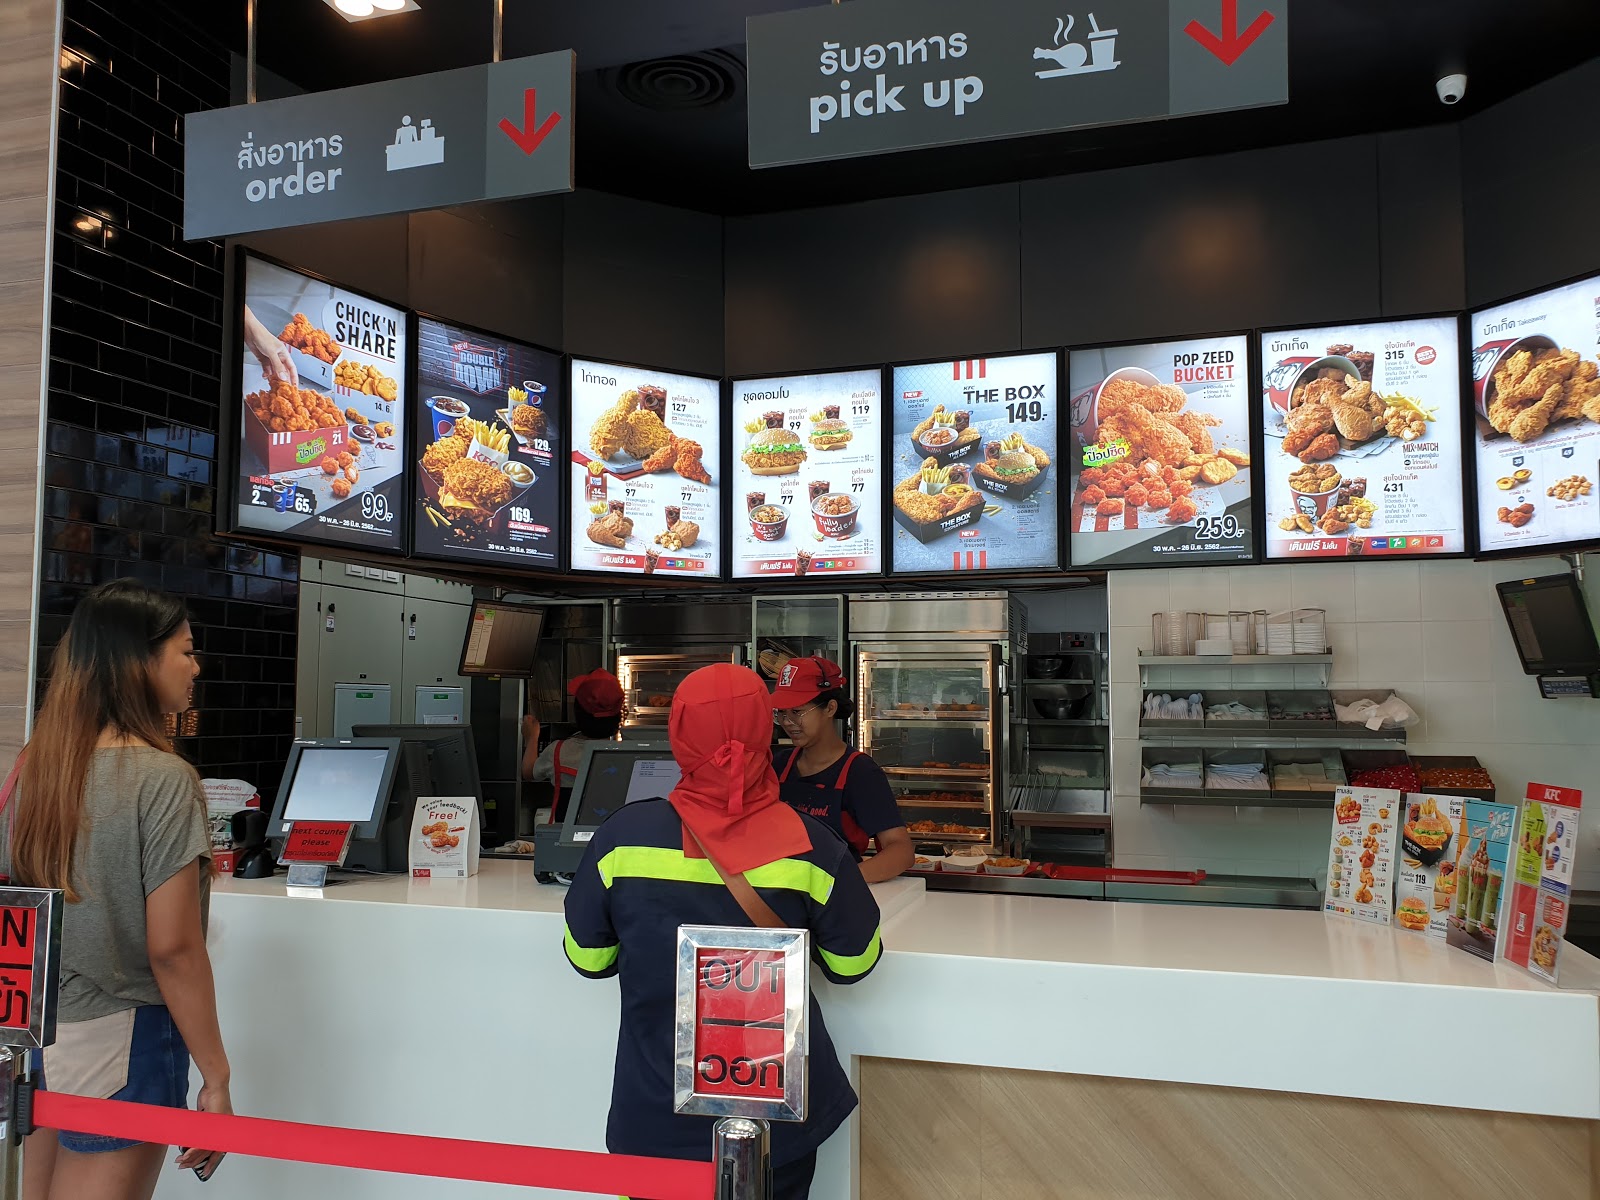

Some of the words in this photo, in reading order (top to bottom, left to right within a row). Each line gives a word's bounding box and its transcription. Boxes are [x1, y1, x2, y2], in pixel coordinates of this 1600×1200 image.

[820, 32, 968, 75] รับอาหาร
[810, 74, 906, 133] pick
[923, 75, 984, 115] up
[238, 132, 343, 169] สั่งอาหาร
[246, 163, 342, 202] order
[335, 301, 397, 337] CHICK'N
[1483, 317, 1516, 336] บักเก็ต
[335, 322, 397, 360] SHARE
[1271, 337, 1309, 353] บักเก็ต
[461, 351, 494, 366] DOUBLE
[1173, 353, 1199, 367] POP
[1202, 350, 1234, 364] ZEED
[1385, 350, 1405, 360] 315
[454, 363, 501, 392] DOWN
[581, 369, 617, 387] ไก่ทอด
[1173, 365, 1234, 383] BUCKET
[743, 386, 790, 404] ชุดคอมโบ
[963, 388, 999, 404] THE
[1005, 384, 1046, 401] BOX
[671, 403, 687, 412] 127
[852, 405, 870, 415] 119
[789, 421, 801, 430] 99
[472, 450, 498, 466] KFC
[626, 488, 636, 497] 97
[851, 483, 864, 492] 77
[995, 482, 1008, 490] BOX
[1383, 483, 1404, 492] 431
[252, 490, 260, 504] 2
[681, 492, 692, 501] 77
[781, 495, 793, 505] 77
[819, 517, 839, 528] fully
[824, 519, 853, 533] loaded
[940, 517, 956, 529] THE
[955, 511, 972, 522] BOX
[1289, 539, 1320, 552] เติมฟรี
[1544, 788, 1562, 802] KFC
[428, 811, 458, 820] Free!
[439, 802, 468, 815] feedback!
[291, 827, 313, 835] next
[314, 828, 348, 836] counter
[301, 839, 331, 847] please
[1415, 873, 1426, 884] 119
[1, 909, 29, 948] N
[703, 958, 785, 994] OUT
[700, 1054, 785, 1089] ออก
